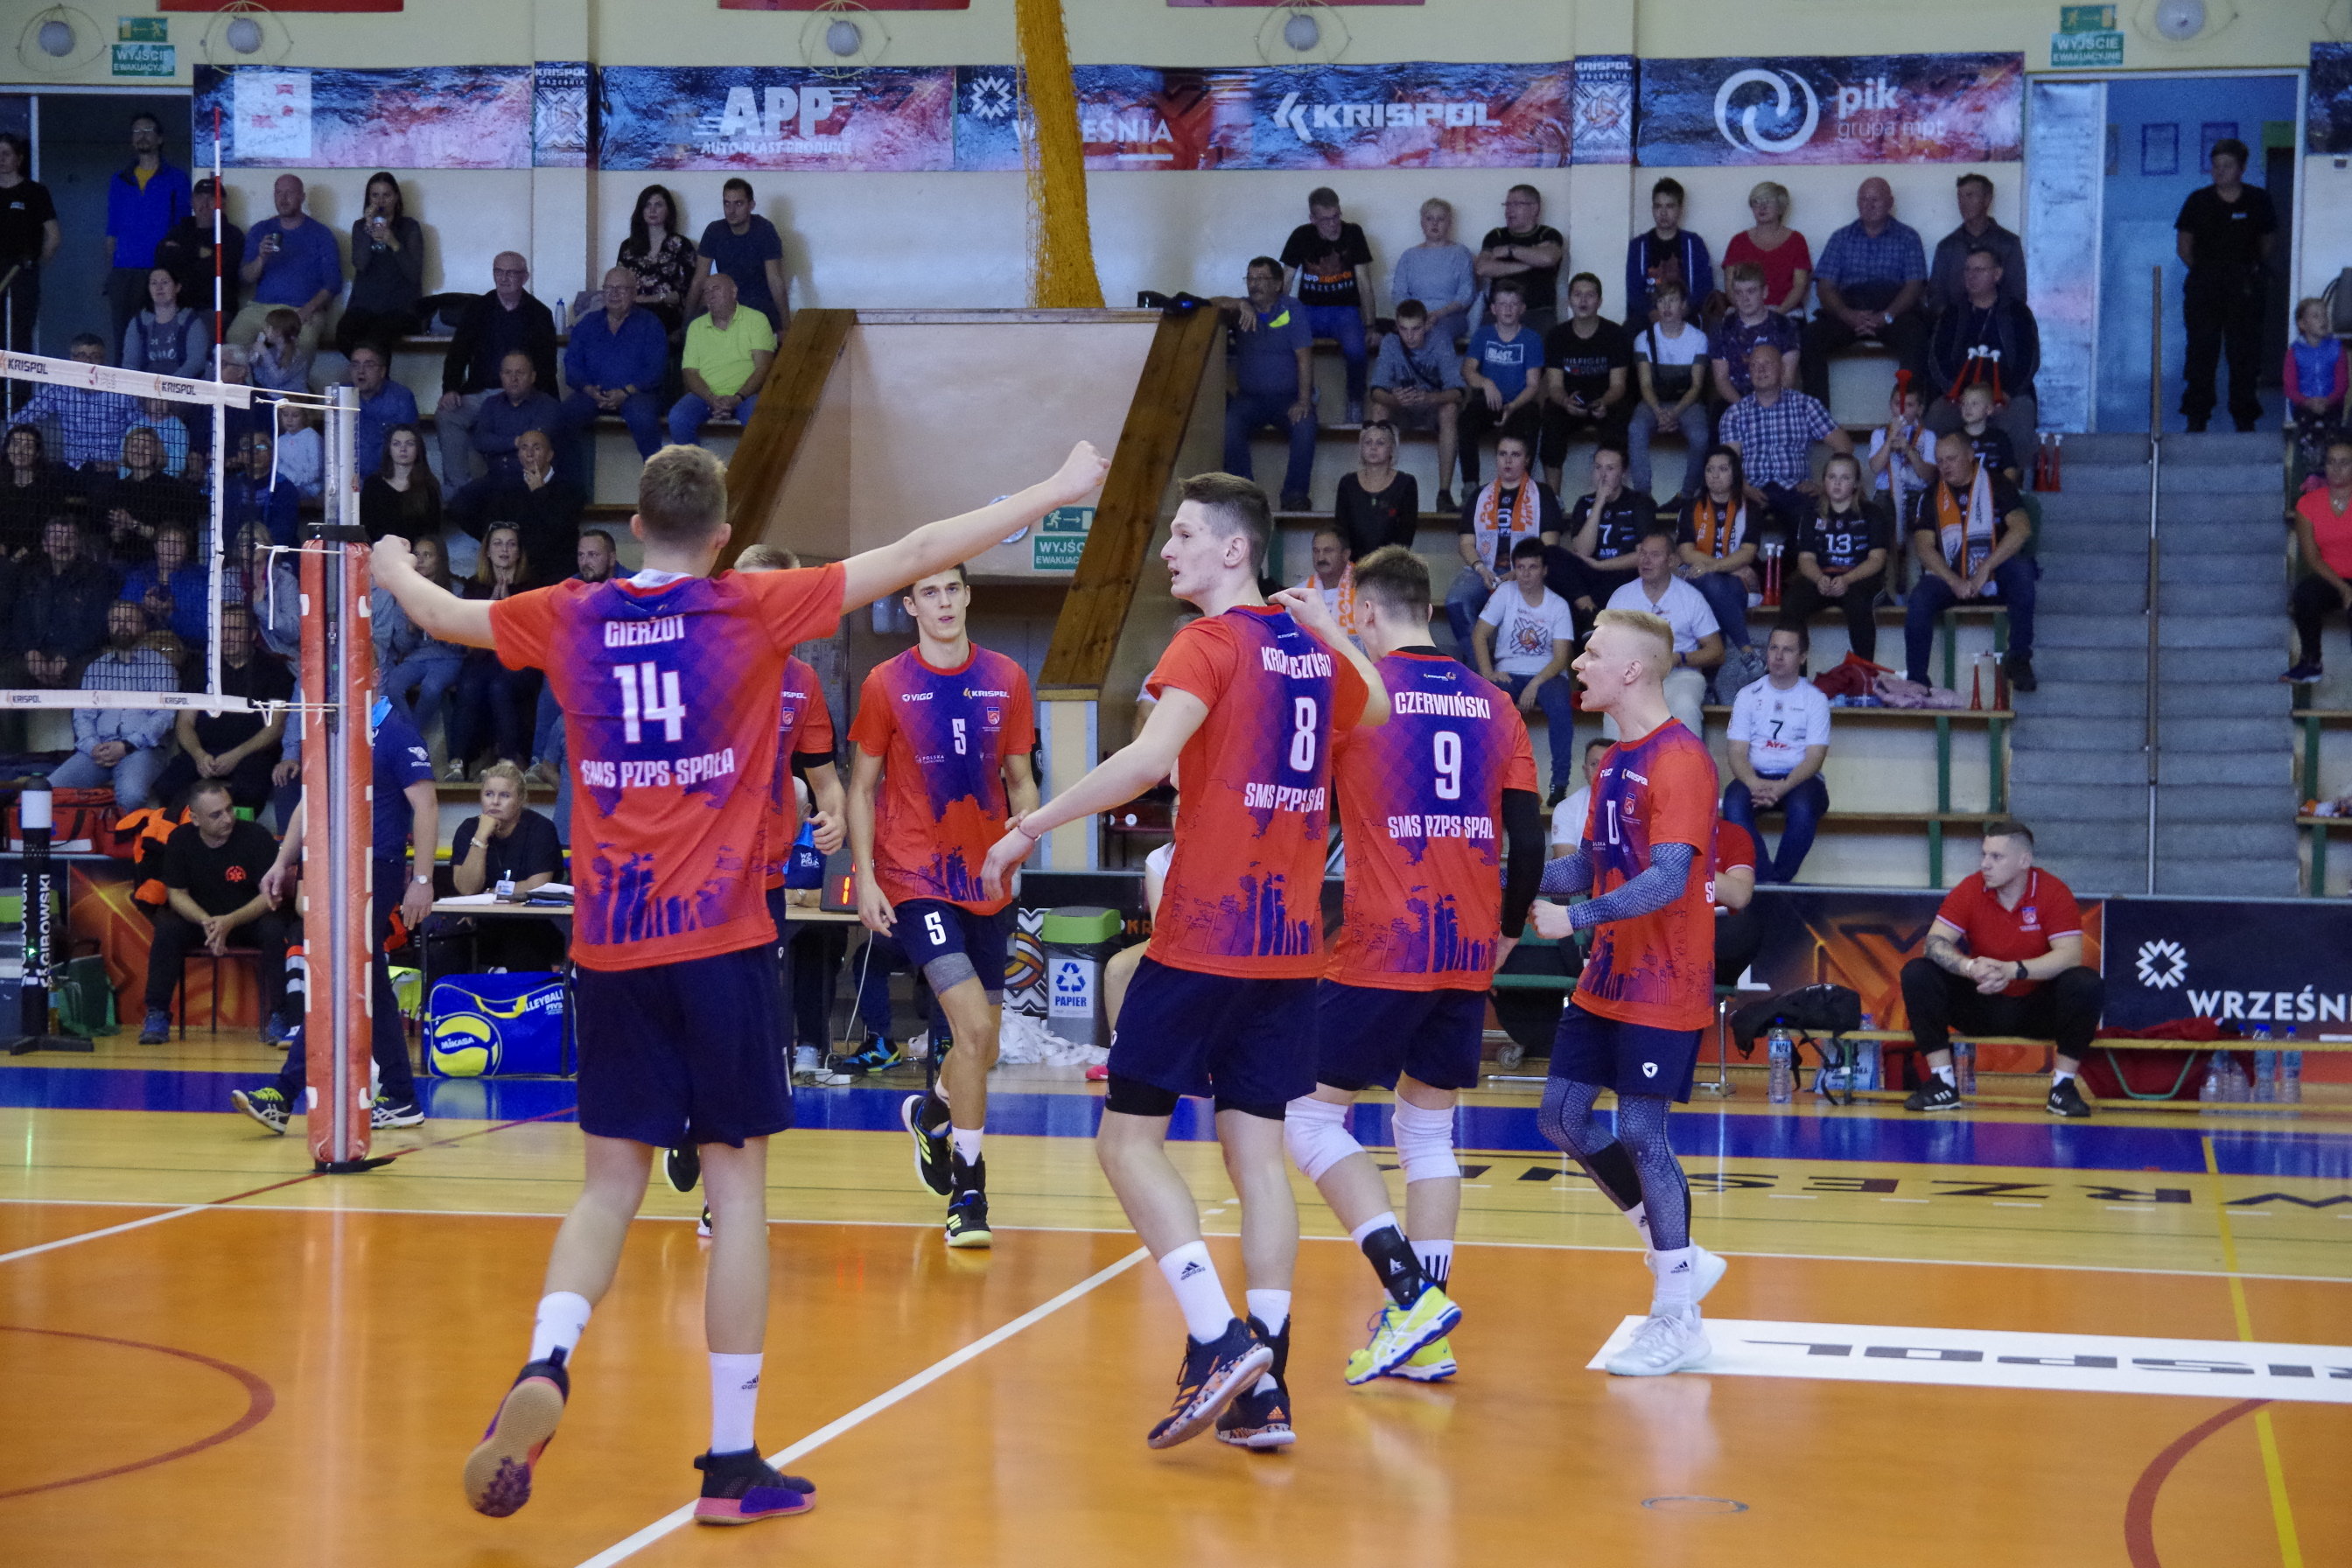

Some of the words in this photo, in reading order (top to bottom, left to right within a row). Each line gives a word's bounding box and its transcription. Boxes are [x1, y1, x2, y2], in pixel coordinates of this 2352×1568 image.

[535, 67, 588, 77] KRISPOL
[1574, 60, 1634, 70] KRISPOL
[1838, 76, 1900, 120] pik
[719, 86, 833, 136] APP
[1313, 102, 1502, 128] KRISPOL
[1012, 114, 1174, 143] WEŚNIA
[1838, 122, 1895, 141] grupa
[1902, 118, 1946, 140] mpt
[7, 357, 49, 375] KRISPOL
[161, 381, 197, 396] KRISPOL
[1039, 538, 1085, 553] WYJŚC
[1599, 523, 1613, 544] 7
[1825, 533, 1852, 553] 13
[1035, 555, 1080, 564] EWAKUAC
[12, 694, 42, 704] KRISPOL
[164, 696, 190, 705] KRISPOL
[613, 661, 687, 744] 14
[1394, 690, 1492, 720] CZERWIŃSKI
[952, 718, 967, 756] 5
[1290, 696, 1318, 773] 8
[1769, 718, 1784, 739] 7
[580, 760, 617, 788] SMS
[620, 759, 672, 788] PZPS
[675, 746, 736, 786] SPAŁA
[1432, 730, 1462, 801] 9
[1243, 782, 1277, 809] SMS
[1388, 814, 1422, 839] SMS
[1424, 814, 1462, 838] PZPS
[924, 911, 947, 946] 5
[1054, 995, 1088, 1008] PAPIER
[2186, 984, 2352, 1023] WRZEŚN
